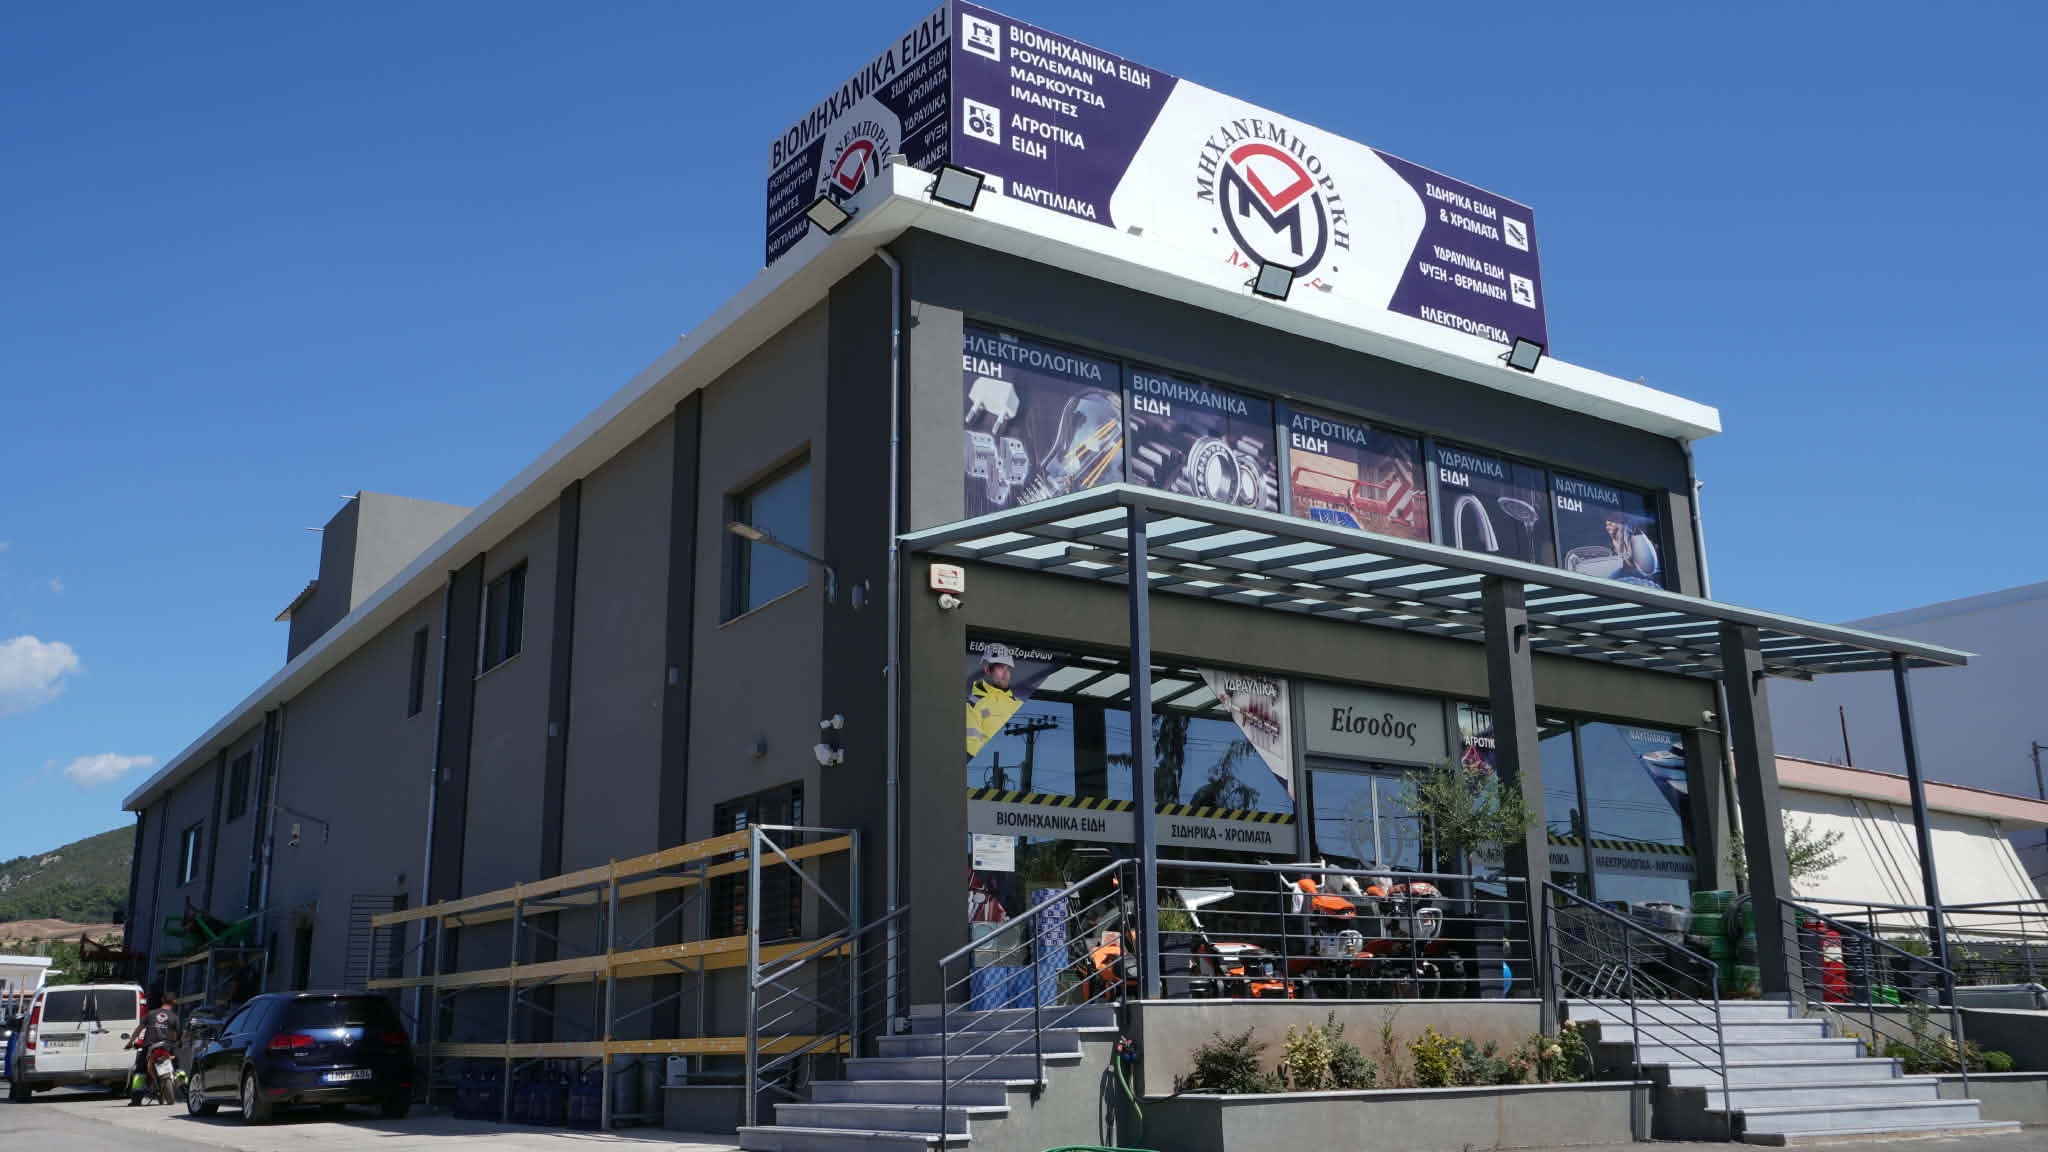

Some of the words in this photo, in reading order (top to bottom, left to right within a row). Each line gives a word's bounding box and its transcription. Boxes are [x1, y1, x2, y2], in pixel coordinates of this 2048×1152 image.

[891, 62, 927, 99] ΣΙΔΗΡΙΚΑ
[929, 45, 947, 70] ΕΙΔΗ
[1009, 26, 1116, 77] ΒΙΟΜΗΧΑΝΙΚΑ
[1119, 66, 1150, 89] ΕΙΔΗ
[1010, 47, 1093, 85] ΡΟΥΛΕΜΑΝ
[772, 54, 896, 169] ΒΙΟΜΗΧΑΝΙΚΑ
[902, 8, 945, 66] ΕΙΔΗ
[908, 66, 947, 108] ΧΡΩΜΑΤΑ
[1010, 66, 1106, 109] ΜΑΡΚΟΥΤΣΙΑ
[1011, 85, 1079, 118] ΙΜΑΝΤΕΣ
[905, 93, 946, 131] ΥΔΡΑΥΛΙΚΑ
[925, 119, 947, 147] ΨΥΞΗ
[1011, 113, 1085, 150] ΑΓΡΟΤΙΚΑ
[1012, 136, 1047, 160] ΕΙΔΗ
[1012, 181, 1096, 219] ΝΑΥΤΙΛΙΑΚΑ
[1197, 118, 1350, 252] ΜΗΧΑΝΕΜΠΟΡΙΚΗ
[1426, 183, 1472, 211] ΣΙΔΗΡΙΚΑ
[1473, 200, 1496, 220] ΕΙΔΗ
[1439, 209, 1448, 223] &
[1450, 212, 1499, 241] ΧΡΩΜΑΤΑ
[1419, 261, 1447, 283] ΨΥΞΗ
[1454, 276, 1507, 301] ΘΕΡΜΑΝΣΗ
[1434, 245, 1483, 273] ΥΔΡΑΥΛΙΚΑ
[1484, 262, 1505, 281] ΕΙΔΗ
[1421, 305, 1510, 344] ΗΛΕΚΤΡΟΛΟΓΙΚΑ
[962, 334, 1101, 381] ΗΛΕΚΤΡΟΛΟΓΙΚΑ
[962, 355, 1002, 378] ΕΙΔΗ
[1133, 374, 1248, 416] ΒΙΟΜΗΧΑΝΙΚΑ
[1133, 394, 1171, 417] ΕΙΔΗ
[1292, 413, 1368, 446] ΑΓΡΟΤΙΚΑ
[1292, 432, 1328, 454] ΕΙΔΗ
[1437, 449, 1504, 479] ΥΔΡΑΥΛΙΚΑ
[1440, 468, 1469, 488] ΕΙΔΗ
[1555, 477, 1619, 505] ΝΑΥΤΙΛΙΑΚΑ
[1557, 495, 1583, 513] ΕΙΔΗ
[1224, 679, 1276, 696] ΥΔΡΑΥΛΙΚΑ
[1331, 706, 1417, 747] Είσοδος
[1464, 736, 1496, 749] ΑΓΡΟΤΙΚ
[996, 811, 1079, 832] ΒΙΟΜΗΧΑΝΙΚΑ
[1081, 817, 1106, 833] ΕΙΔΗ
[1171, 824, 1216, 840] ΣΙΔΗΡΙΚΑ
[1224, 828, 1272, 844] ΧΡΩΜΑΤΑ
